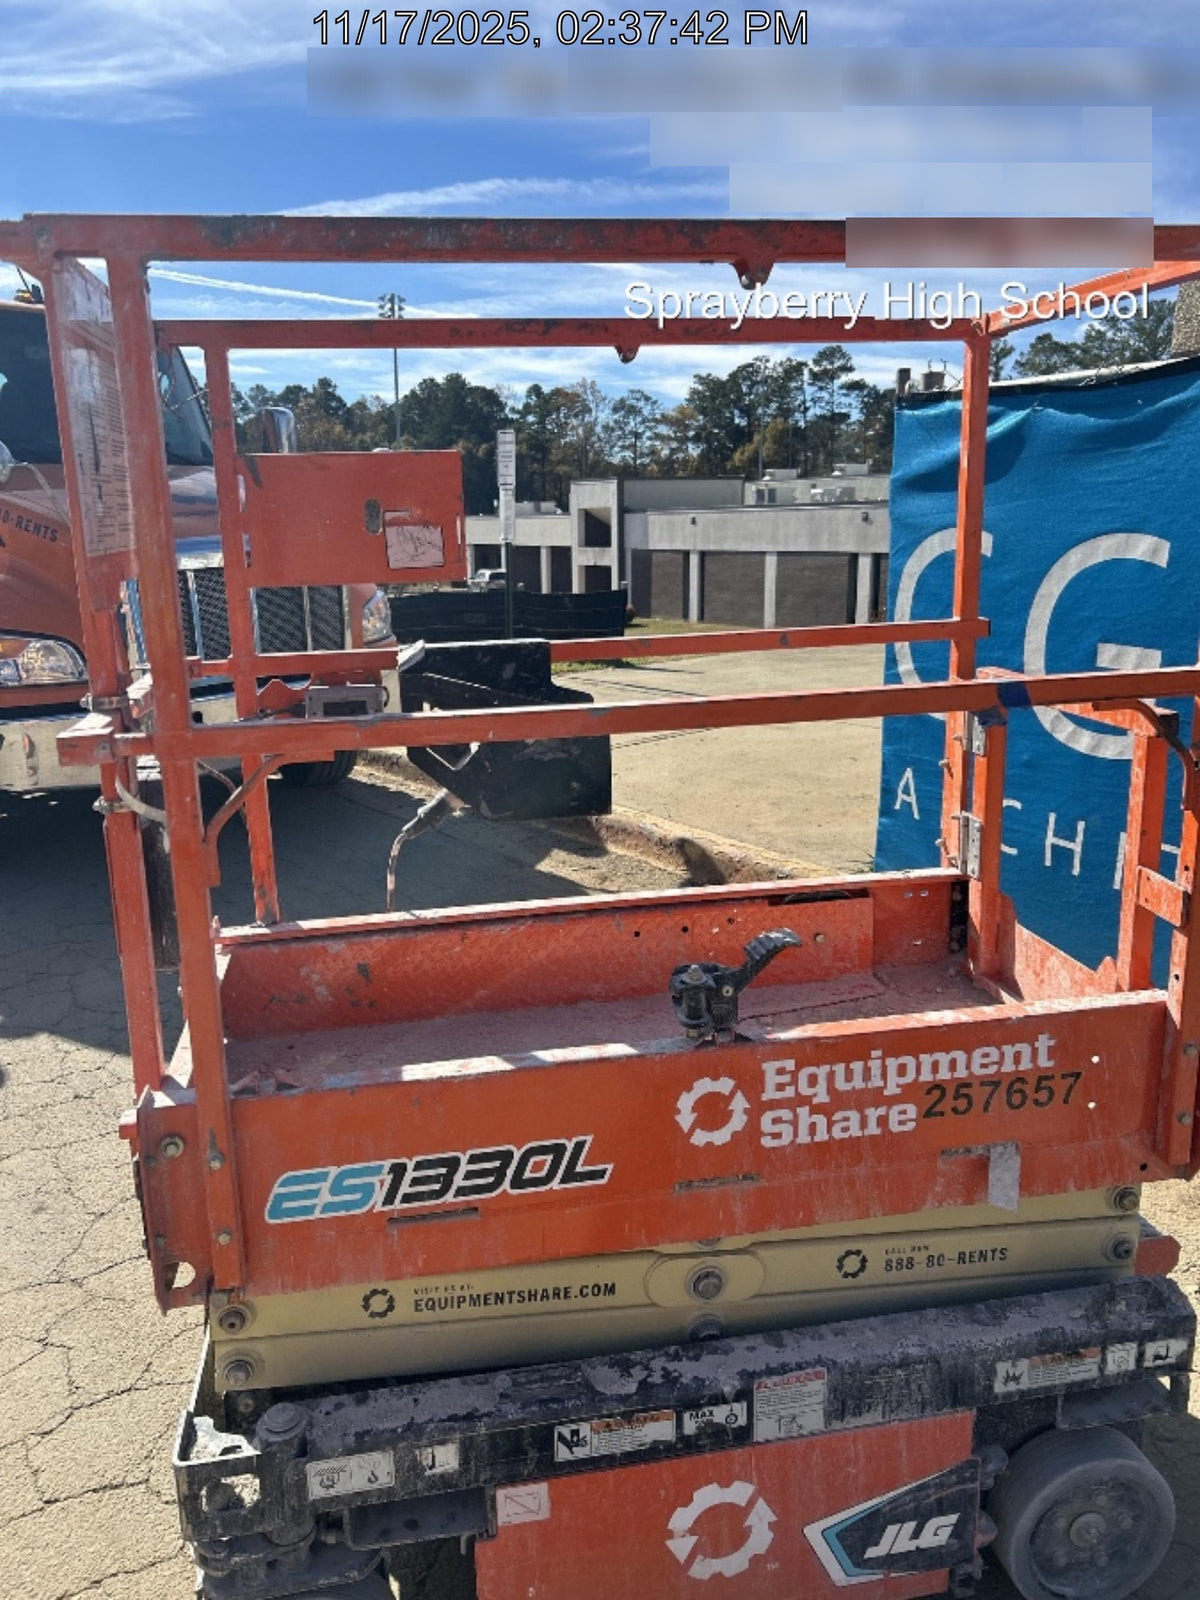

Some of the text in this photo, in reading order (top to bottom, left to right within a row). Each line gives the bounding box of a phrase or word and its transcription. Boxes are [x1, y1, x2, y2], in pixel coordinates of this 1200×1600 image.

[0, 508, 58, 543] 0-RENTS
[761, 1033, 1056, 1104] Equipment
[922, 1071, 1082, 1119] 257657
[760, 1103, 917, 1148] Share
[264, 1134, 614, 1224] ES1330L
[413, 1283, 617, 1313] EQUIPMENTSHARE.COM
[863, 1512, 961, 1560] JLG
